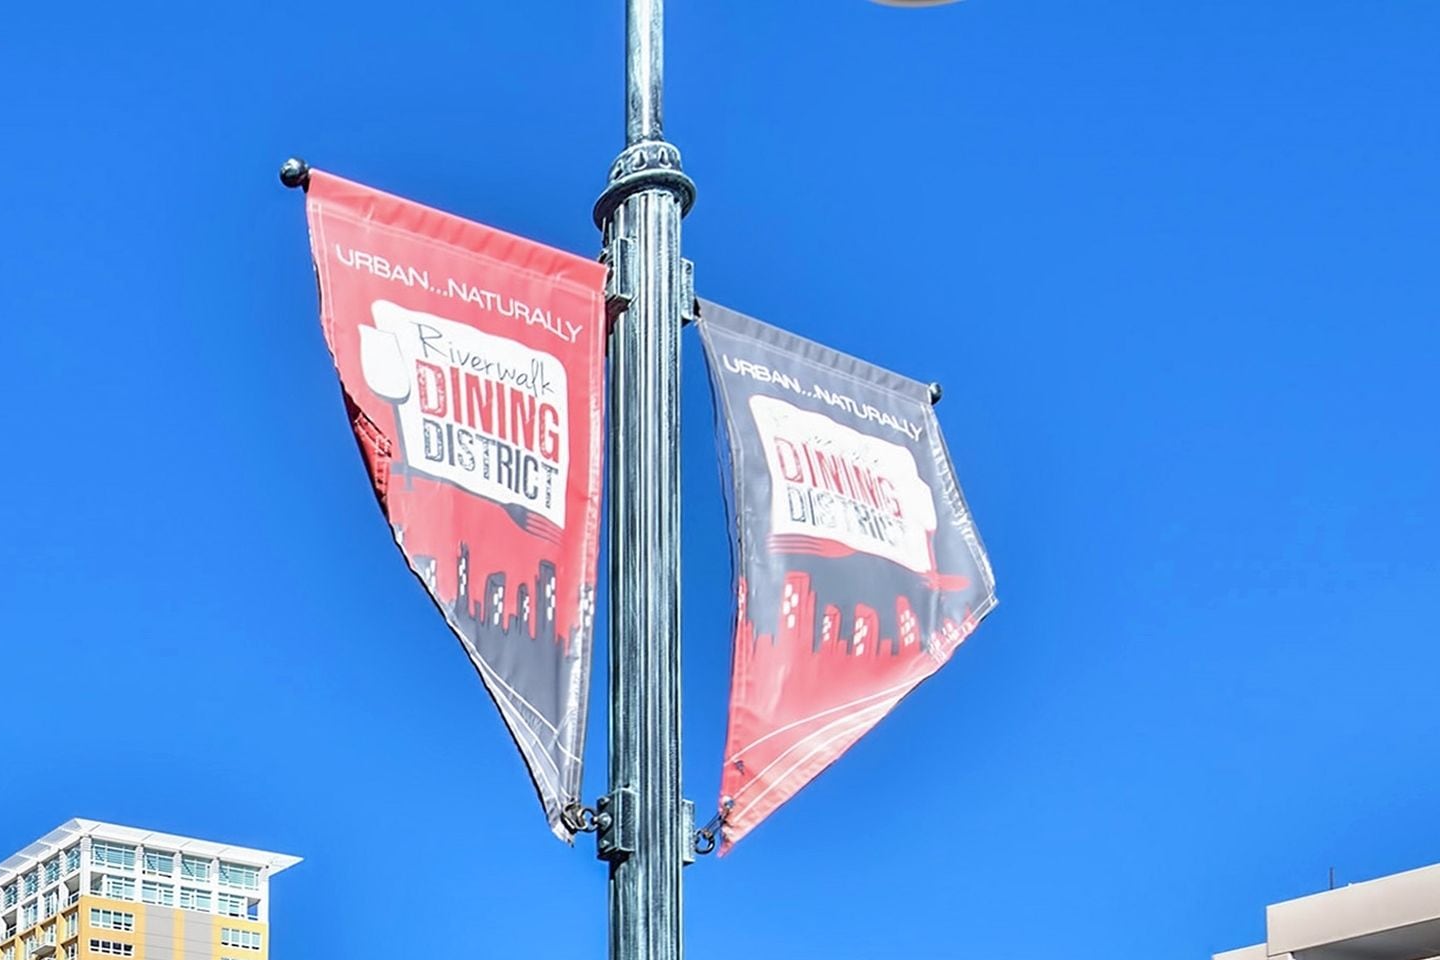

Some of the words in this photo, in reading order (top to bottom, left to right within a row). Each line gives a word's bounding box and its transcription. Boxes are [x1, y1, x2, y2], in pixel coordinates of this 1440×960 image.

[411, 321, 555, 398] Riverwalk
[415, 358, 559, 464] DINING
[422, 418, 559, 509] DISTRICT
[773, 436, 903, 519] DINING
